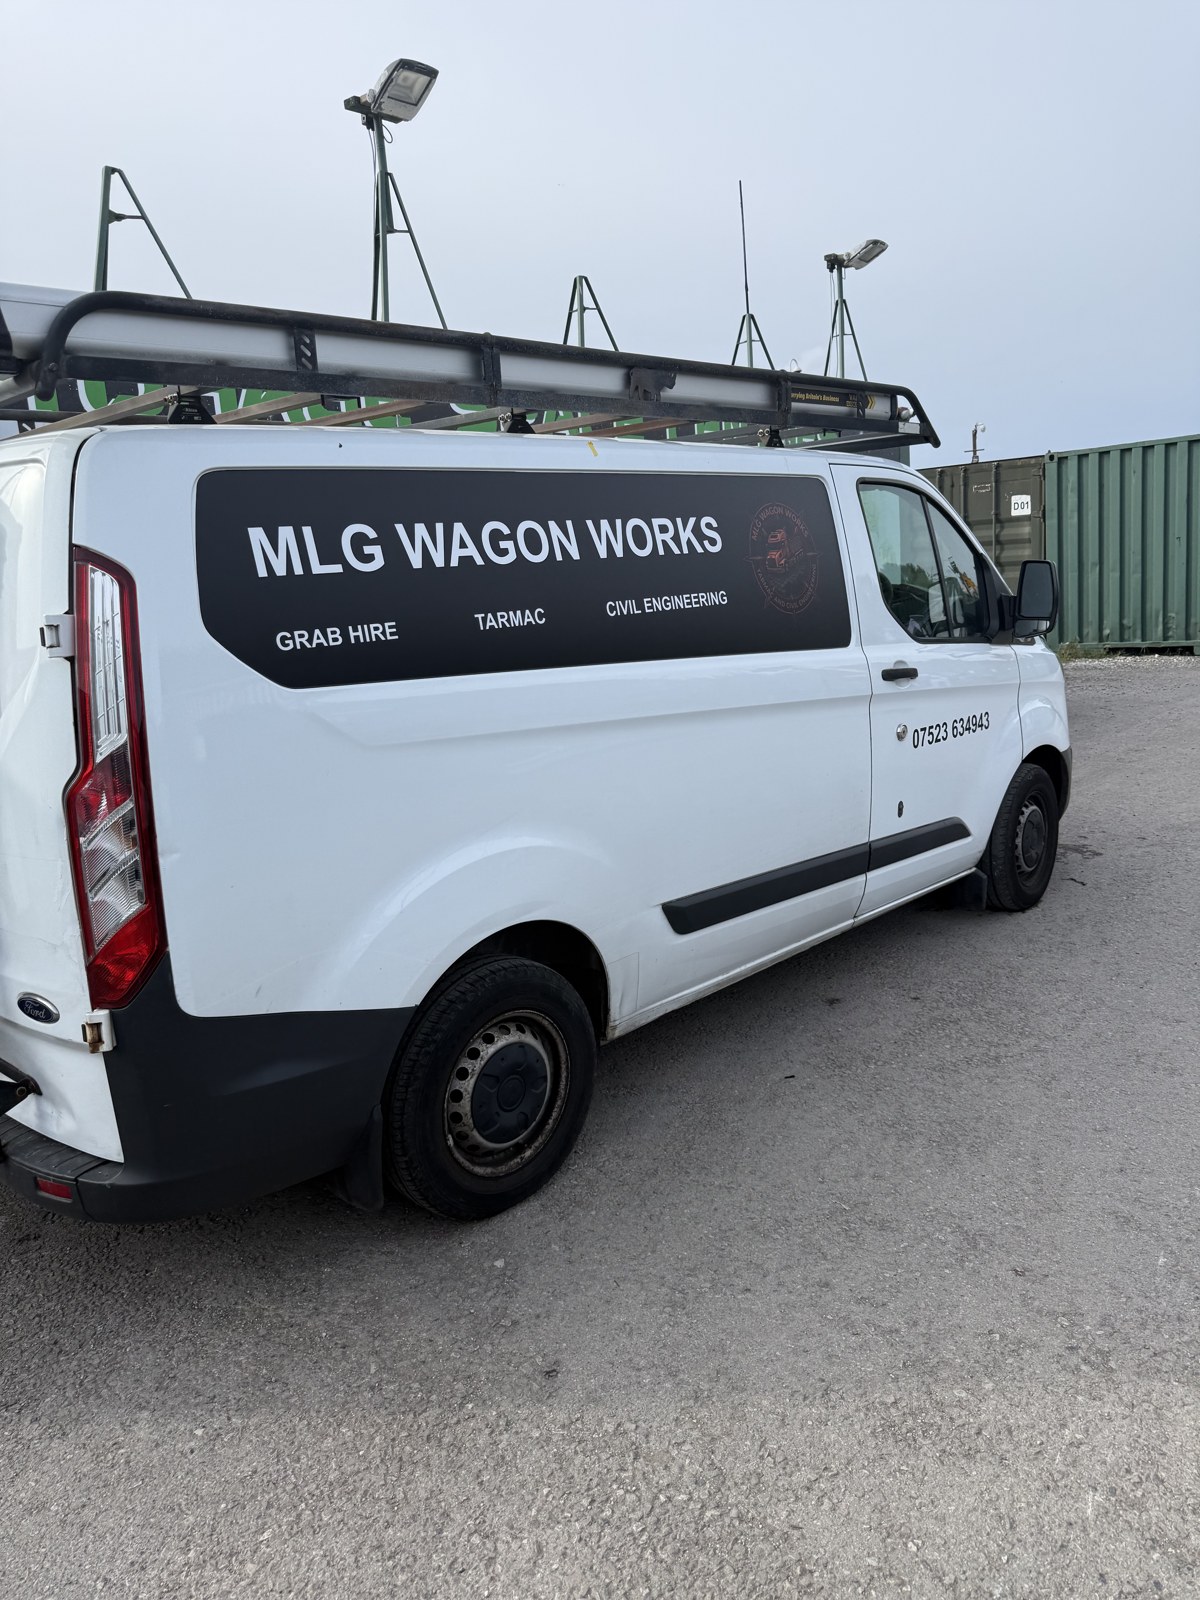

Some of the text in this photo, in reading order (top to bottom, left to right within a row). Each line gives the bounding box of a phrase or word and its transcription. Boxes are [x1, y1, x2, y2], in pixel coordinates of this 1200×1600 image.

[1013, 501, 1029, 511] D01
[751, 505, 809, 541] MLG WAGON WORKS
[248, 516, 723, 577] MLG WAGON WORKS
[606, 590, 728, 617] CIVIL ENGINEERING
[474, 607, 546, 631] TARMAC
[275, 621, 399, 651] GRAB HIRE
[912, 711, 990, 749] 07523 634943
[25, 1001, 46, 1019] Ford
